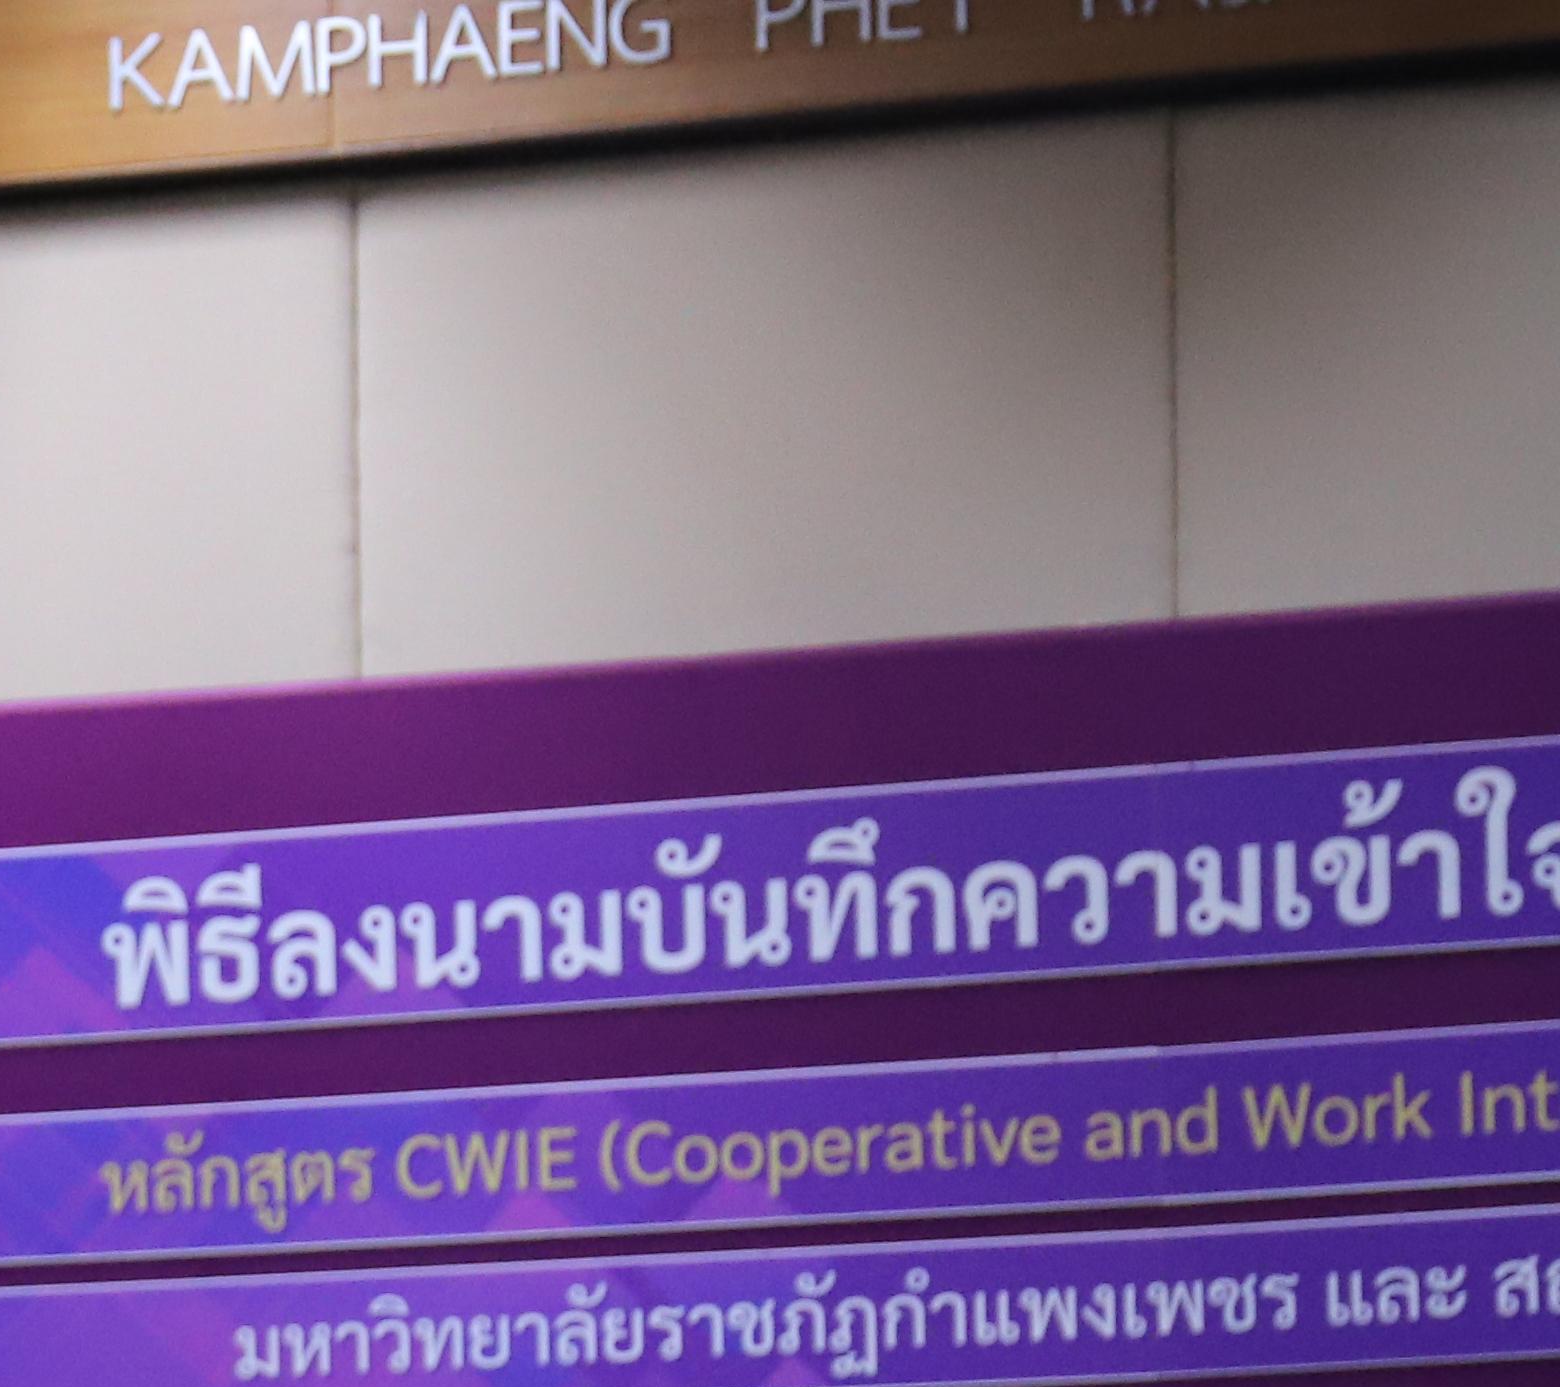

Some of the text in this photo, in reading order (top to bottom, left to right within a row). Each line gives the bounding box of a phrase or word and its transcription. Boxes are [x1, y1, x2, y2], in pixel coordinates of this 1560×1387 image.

[107, 0, 672, 110] KAMPHAENG
[99, 1130, 374, 1233] หลักสูตร
[395, 1126, 579, 1199] CWIE
[598, 1103, 1062, 1197] (Cooperative
[1083, 1086, 1220, 1161] and
[1242, 1072, 1434, 1152] Work
[232, 1265, 1300, 1382] มหาวิทยาลัยราชภัฏกำแพงเพชร
[1325, 1263, 1468, 1328] และ
